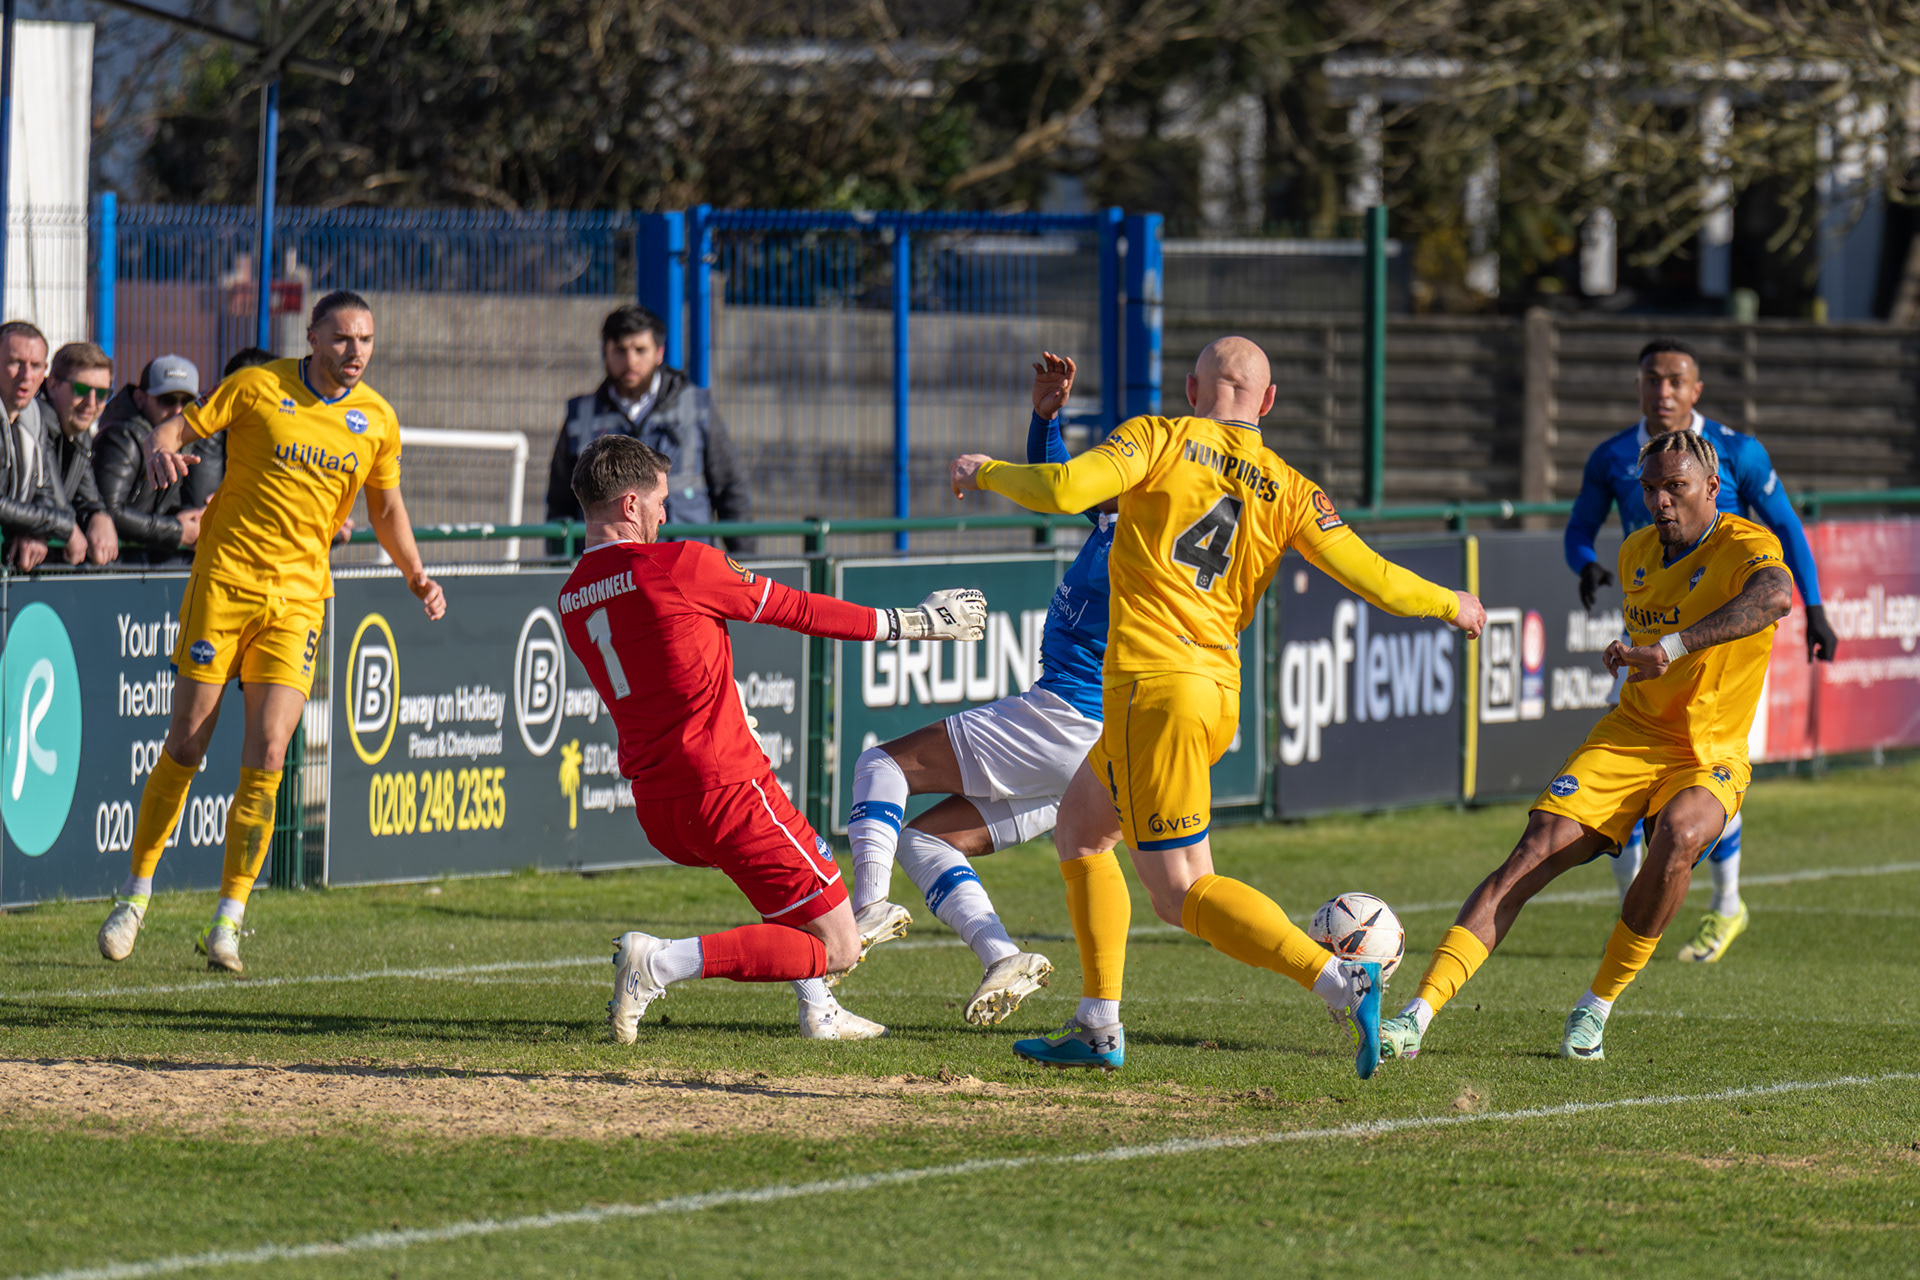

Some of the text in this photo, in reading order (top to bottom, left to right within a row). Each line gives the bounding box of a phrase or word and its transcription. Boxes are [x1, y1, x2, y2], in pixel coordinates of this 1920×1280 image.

[275, 442, 340, 471] utilita
[1183, 437, 1281, 503] HUMPHRES
[1171, 492, 1245, 592] 4
[559, 570, 637, 615] McDONNELL
[117, 612, 161, 658] Your
[303, 628, 317, 663] 5
[585, 606, 632, 700] 1
[118, 669, 176, 717] health
[399, 694, 435, 732] away
[436, 693, 454, 723] on
[455, 684, 505, 729] Holiday
[564, 687, 600, 724] away
[369, 765, 506, 837] 0208 248 2355
[95, 800, 134, 853] 020
